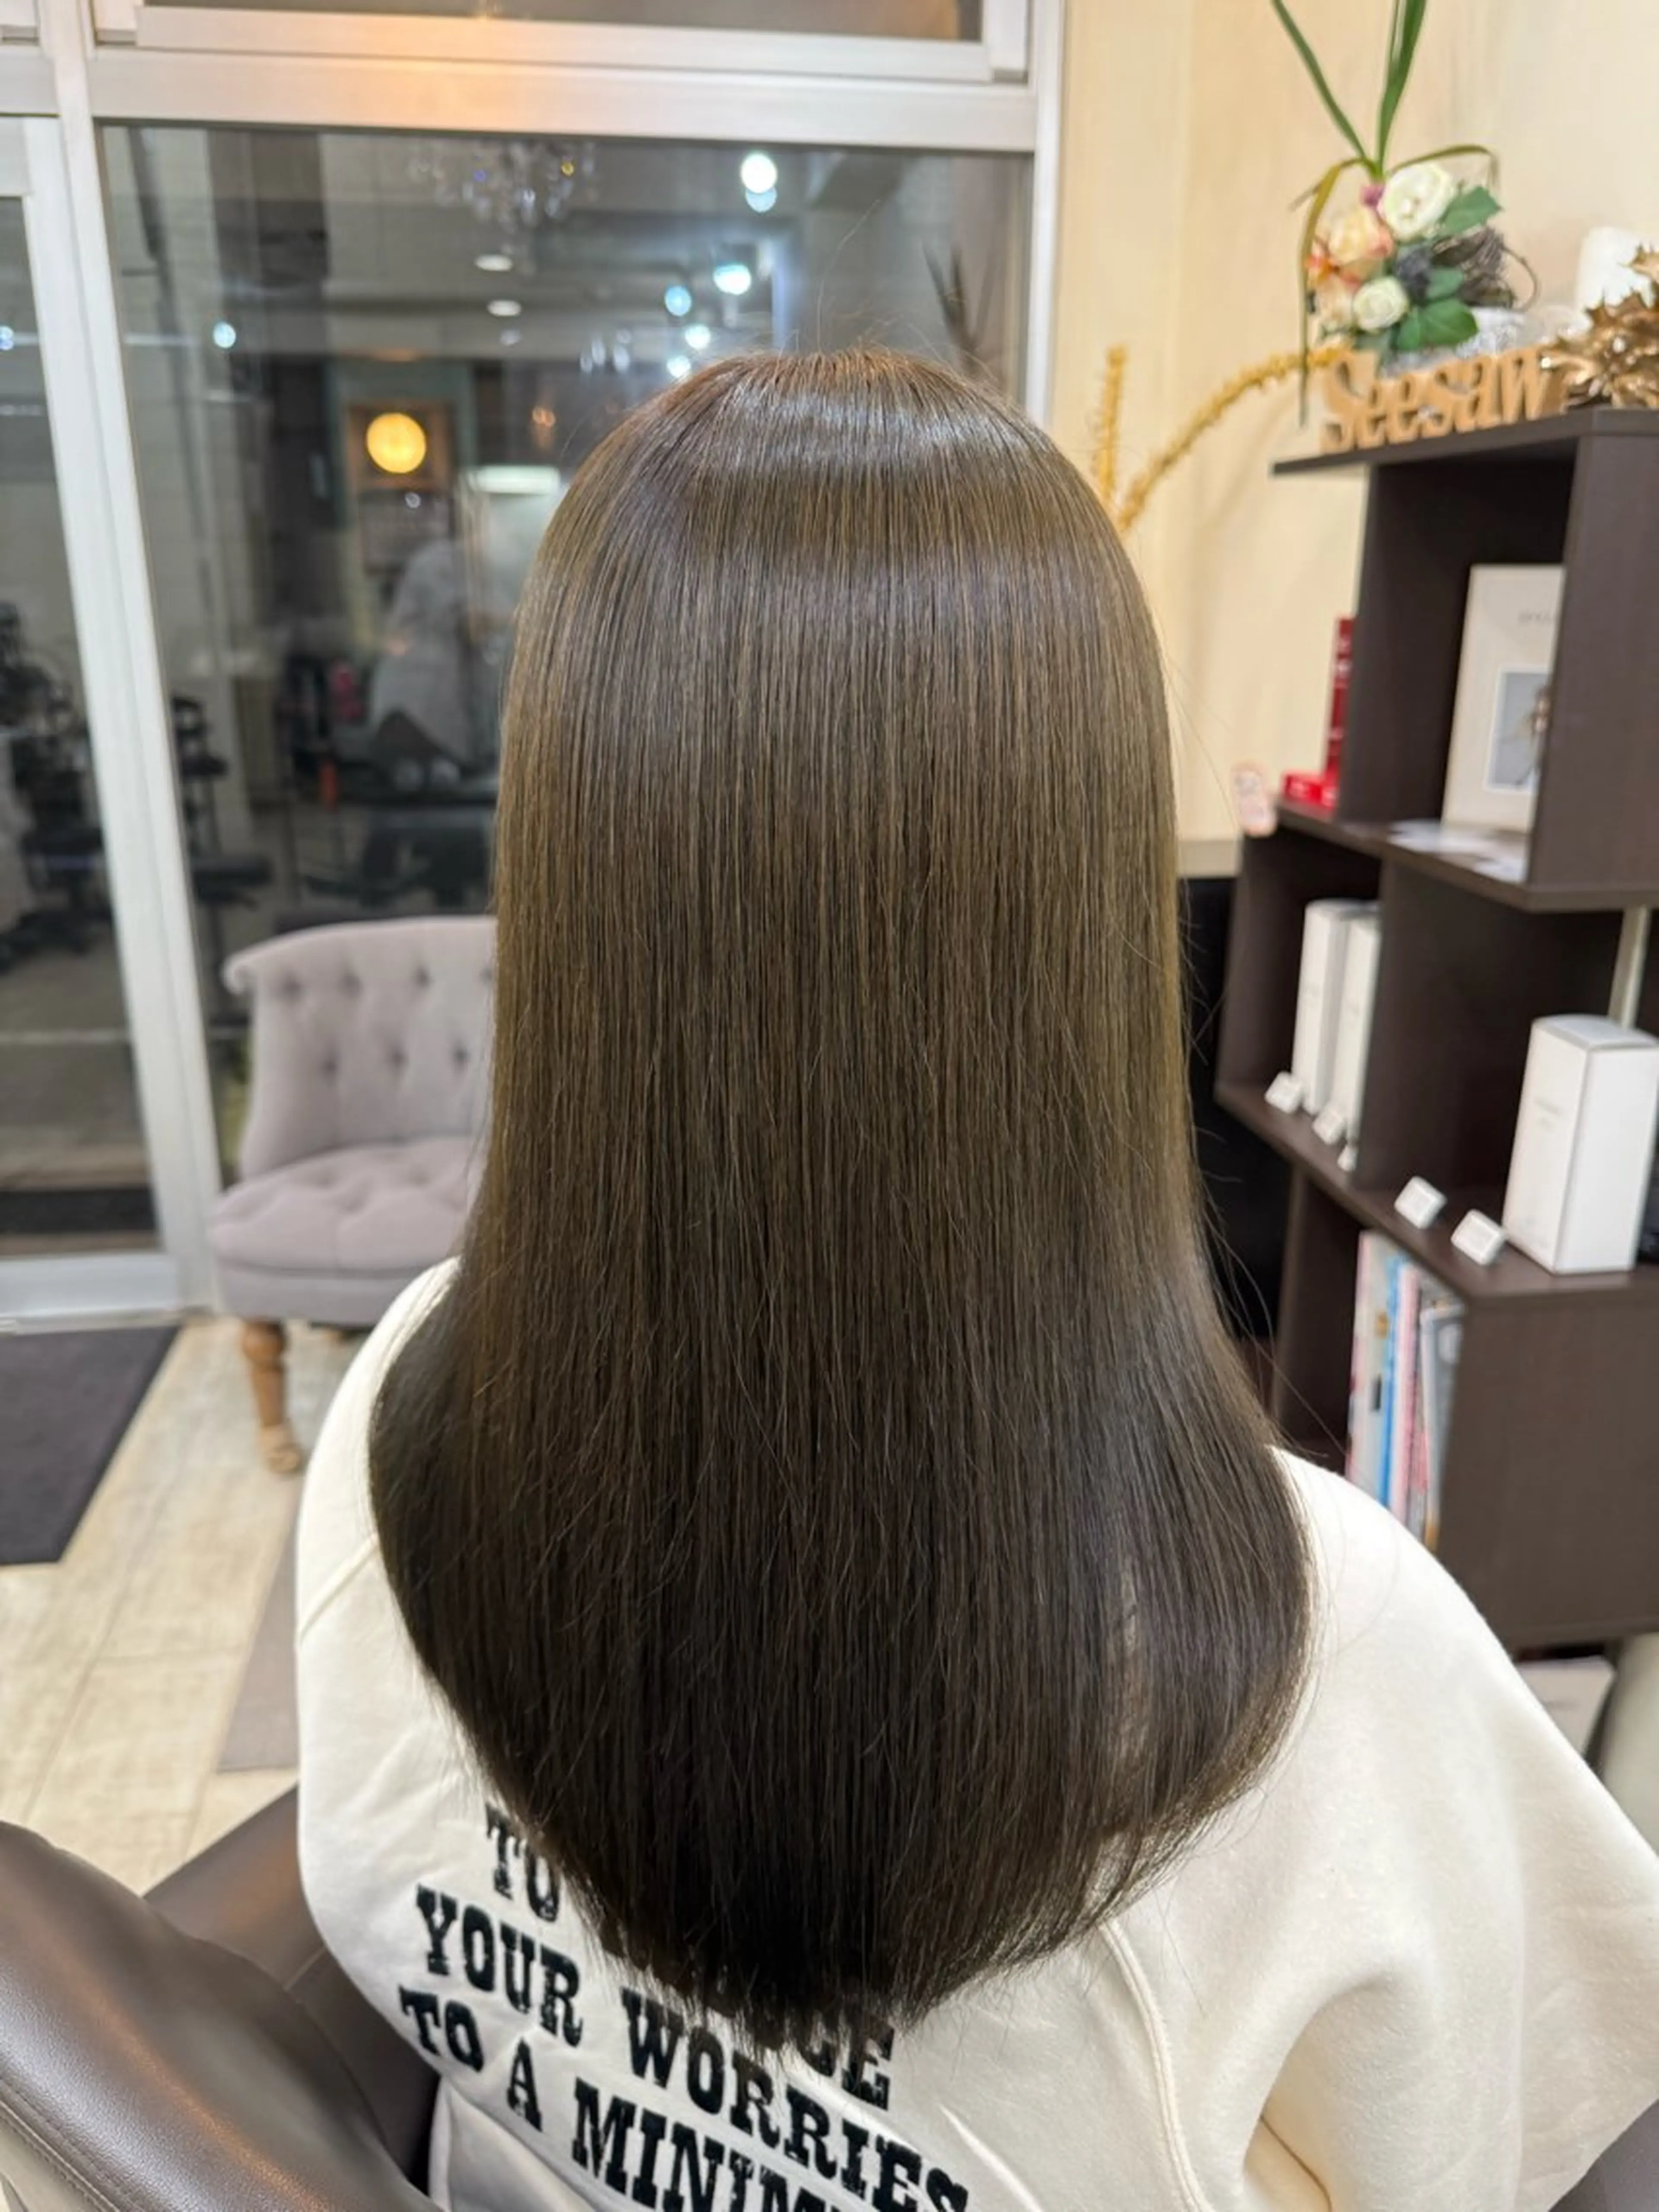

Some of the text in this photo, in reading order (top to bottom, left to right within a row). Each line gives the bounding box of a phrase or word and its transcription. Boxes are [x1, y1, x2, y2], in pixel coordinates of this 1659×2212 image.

[486, 1802, 560, 1923] TO
[416, 1883, 583, 2047] YOUR
[398, 1984, 484, 2072] TO
[507, 2037, 543, 2133] A
